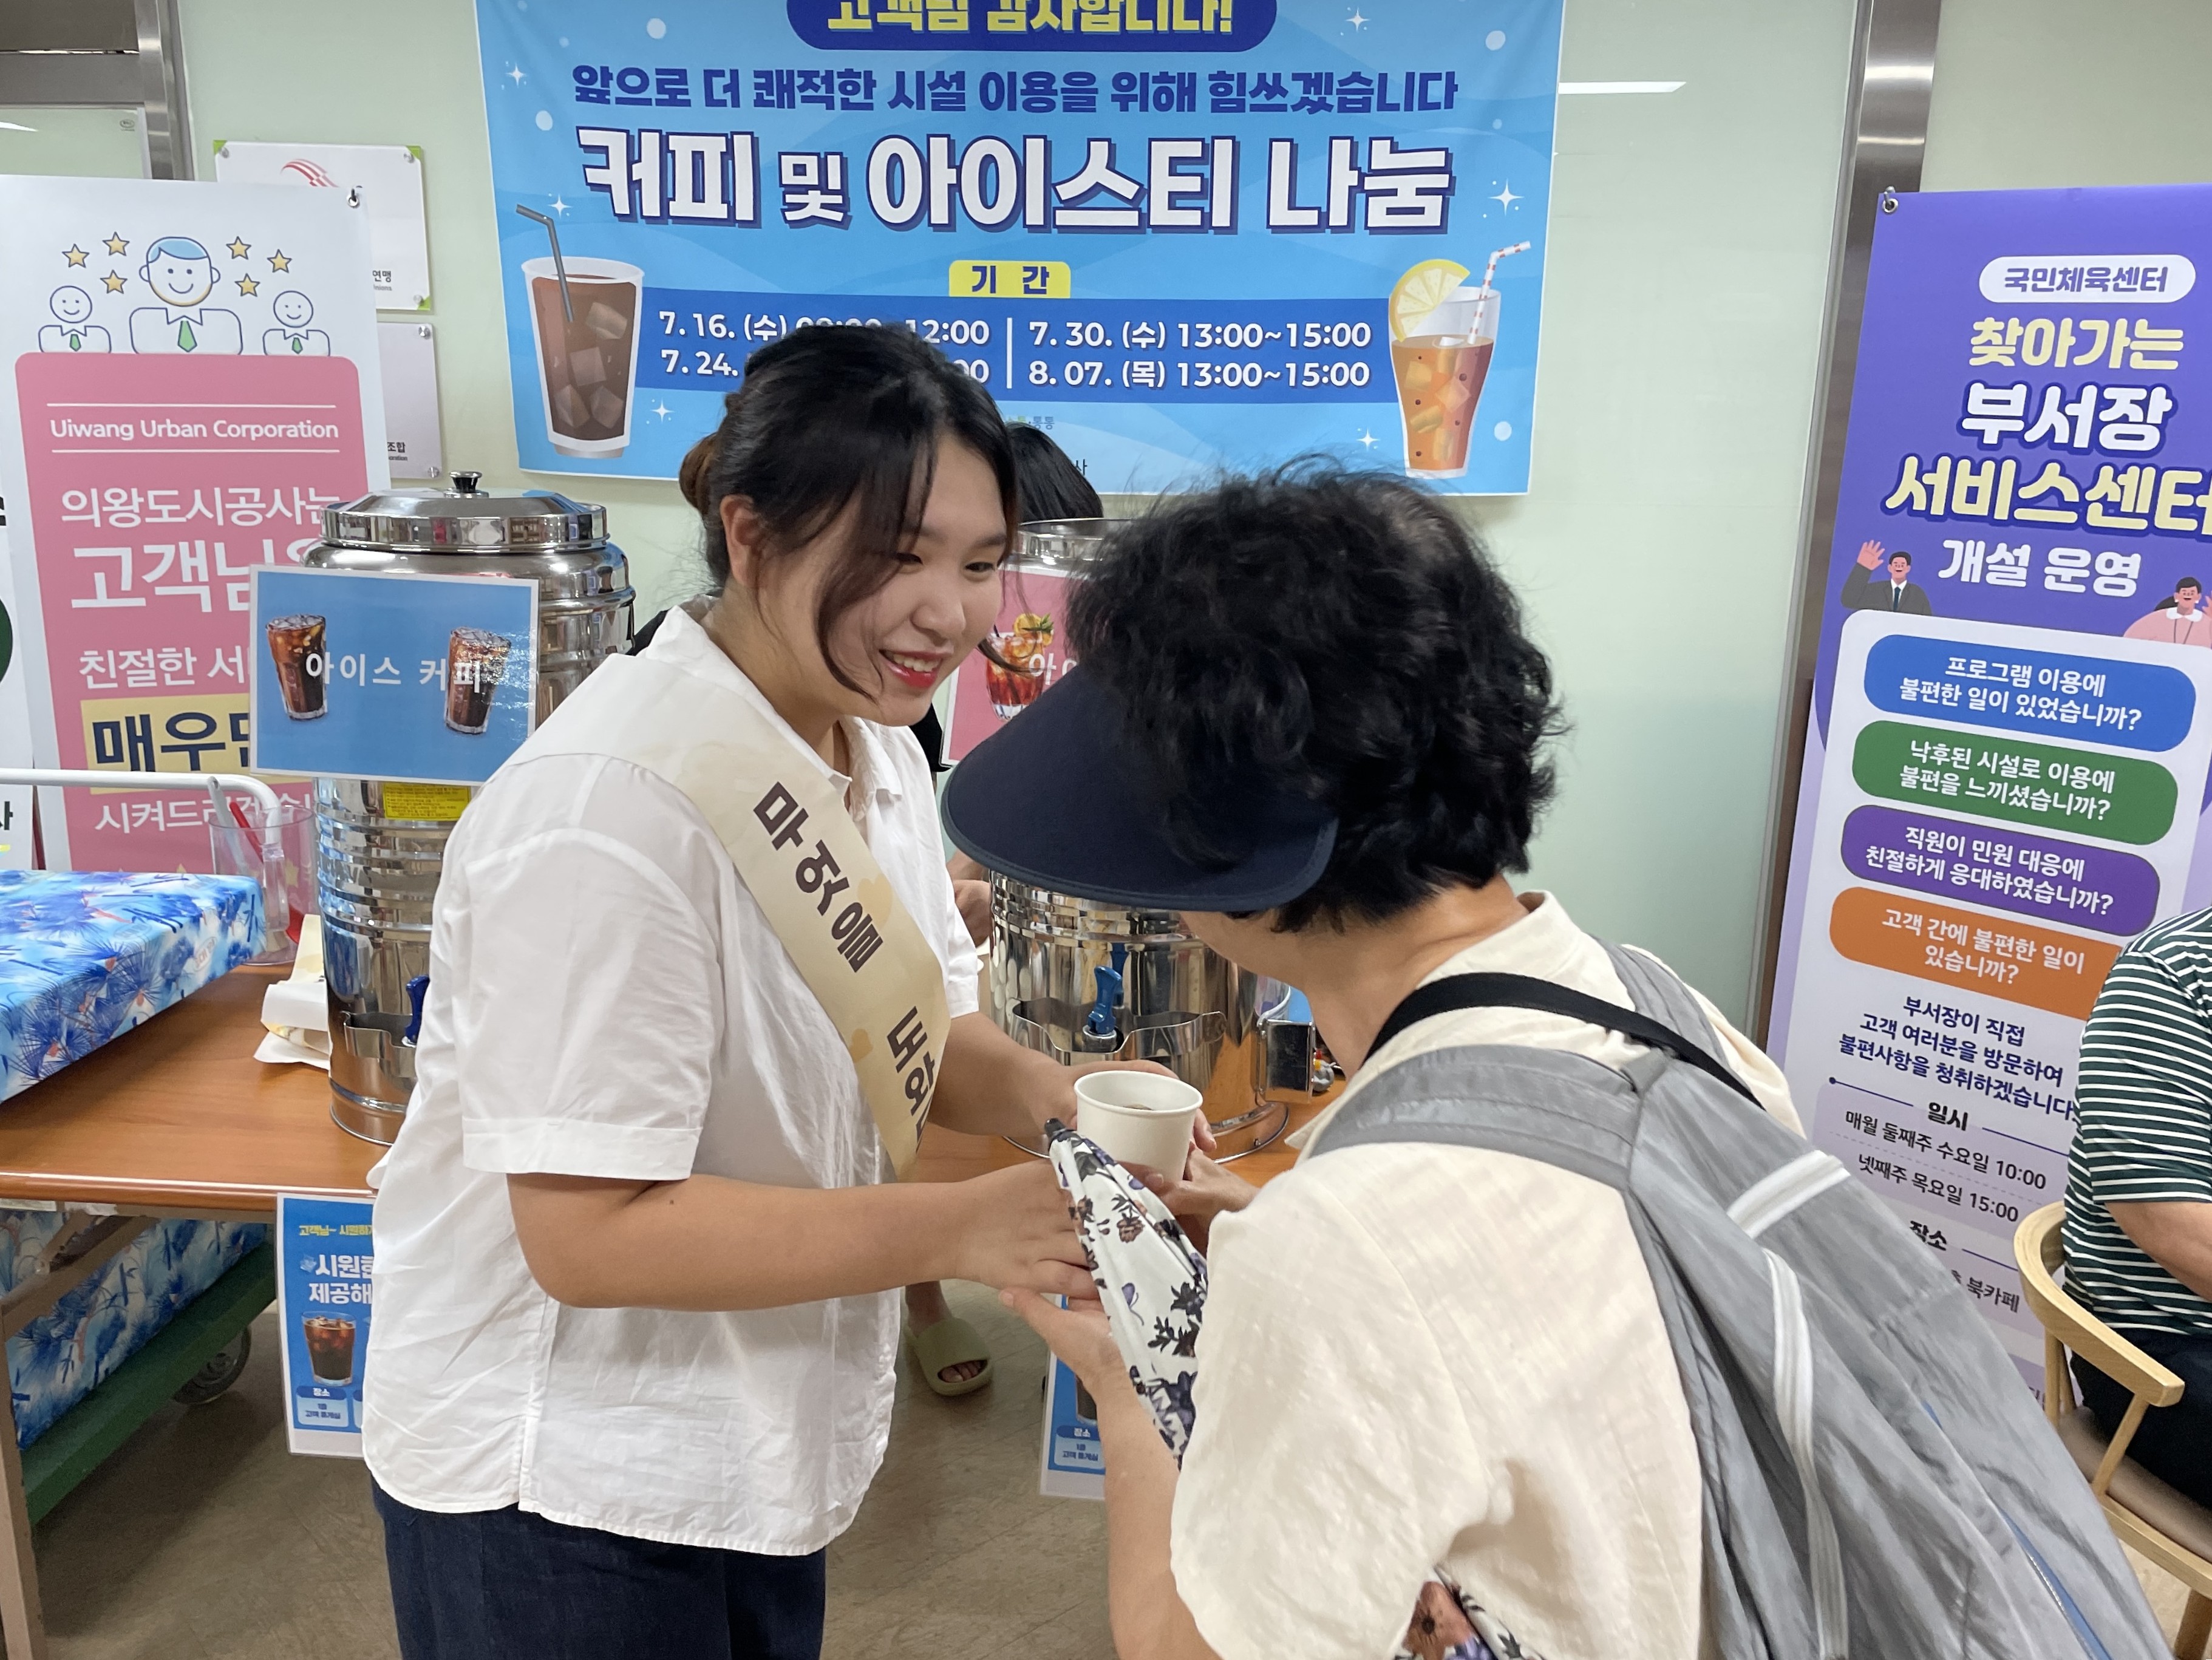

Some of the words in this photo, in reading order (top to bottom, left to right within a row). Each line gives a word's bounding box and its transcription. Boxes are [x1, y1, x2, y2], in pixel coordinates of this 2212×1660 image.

[572, 64, 691, 107] 앞으로
[703, 68, 740, 108] 더
[753, 68, 876, 111] 쾌적한
[887, 70, 967, 112] 시설
[979, 71, 1098, 113] 이용을
[1111, 71, 1197, 112] 위해
[1208, 70, 1458, 115] 힘쓰겠습니다
[576, 126, 760, 228] 커피
[778, 151, 852, 230] 및
[866, 134, 1240, 234] 아이스티
[1266, 136, 1456, 234] 나눔
[2004, 266, 2169, 294] 국민체육센터
[692, 313, 735, 339] 16.
[744, 313, 788, 341] (수)
[1065, 321, 1112, 349] 30.
[1121, 321, 1166, 350] (수)
[1177, 321, 1372, 349] 13:00~15:00
[1969, 317, 2185, 370] 찾아가는
[695, 351, 739, 376] 24.
[1064, 361, 1112, 388] 07.
[1121, 361, 1166, 390] (목)
[1177, 361, 1371, 389] 13:00~15:00
[50, 419, 134, 440] Uiwang
[140, 419, 208, 438] Urban
[213, 419, 339, 440] Corporation
[1958, 381, 2177, 454] 부서장
[61, 487, 340, 528] 의왕도시공사는
[1882, 453, 2212, 539] 서비스센터
[1938, 539, 2031, 588] 개설
[2044, 546, 2142, 597] 운영
[79, 646, 198, 689] 친절한
[305, 652, 401, 687] 아이스
[419, 658, 481, 693] 커피
[1945, 656, 2032, 689] 프로그램
[2038, 668, 2106, 698] 이용에
[1899, 678, 1962, 706] 불편한
[1968, 689, 2009, 713] 일이
[2015, 695, 2142, 731] 있었습니까?
[1910, 740, 1972, 770] 낙후된
[1976, 751, 2041, 780] 시설로
[2048, 763, 2115, 794] 이용에
[1899, 766, 1961, 795] 불편을
[1965, 777, 2111, 821] 느끼셨습니까?
[754, 781, 883, 973] 무엇을
[1905, 826, 1965, 858] 직원이
[1972, 840, 2013, 866] 민원
[2019, 848, 2085, 882] 대응에
[1865, 845, 1945, 881] 친절하게
[1950, 864, 2114, 916] 응대하였습니까?
[1882, 908, 1923, 937] 고객
[1927, 918, 1967, 947] 간에
[1973, 929, 2037, 963] 불편한
[2042, 945, 2084, 974] 일이
[1925, 945, 2020, 985] 있습니까?
[1903, 996, 1980, 1030] 부서장이
[1986, 1018, 2025, 1047] 직접
[1839, 1034, 1931, 1077] 불편사항을
[1860, 1013, 1898, 1040] 고객
[1902, 1024, 1978, 1064] 여러분을
[1984, 1047, 2064, 1088] 방문하여
[1927, 1101, 1969, 1131] 일시
[1845, 1110, 1879, 1137] 매월
[1882, 1123, 1933, 1154] 둘째주
[1937, 1137, 1989, 1172] 수요일
[1995, 1160, 2047, 1191] 10:00
[1859, 1154, 1908, 1185] 넷째주
[1911, 1171, 1963, 1206] 목요일
[1969, 1192, 2019, 1223] 15:00
[1967, 1277, 2020, 1313] 북카페
